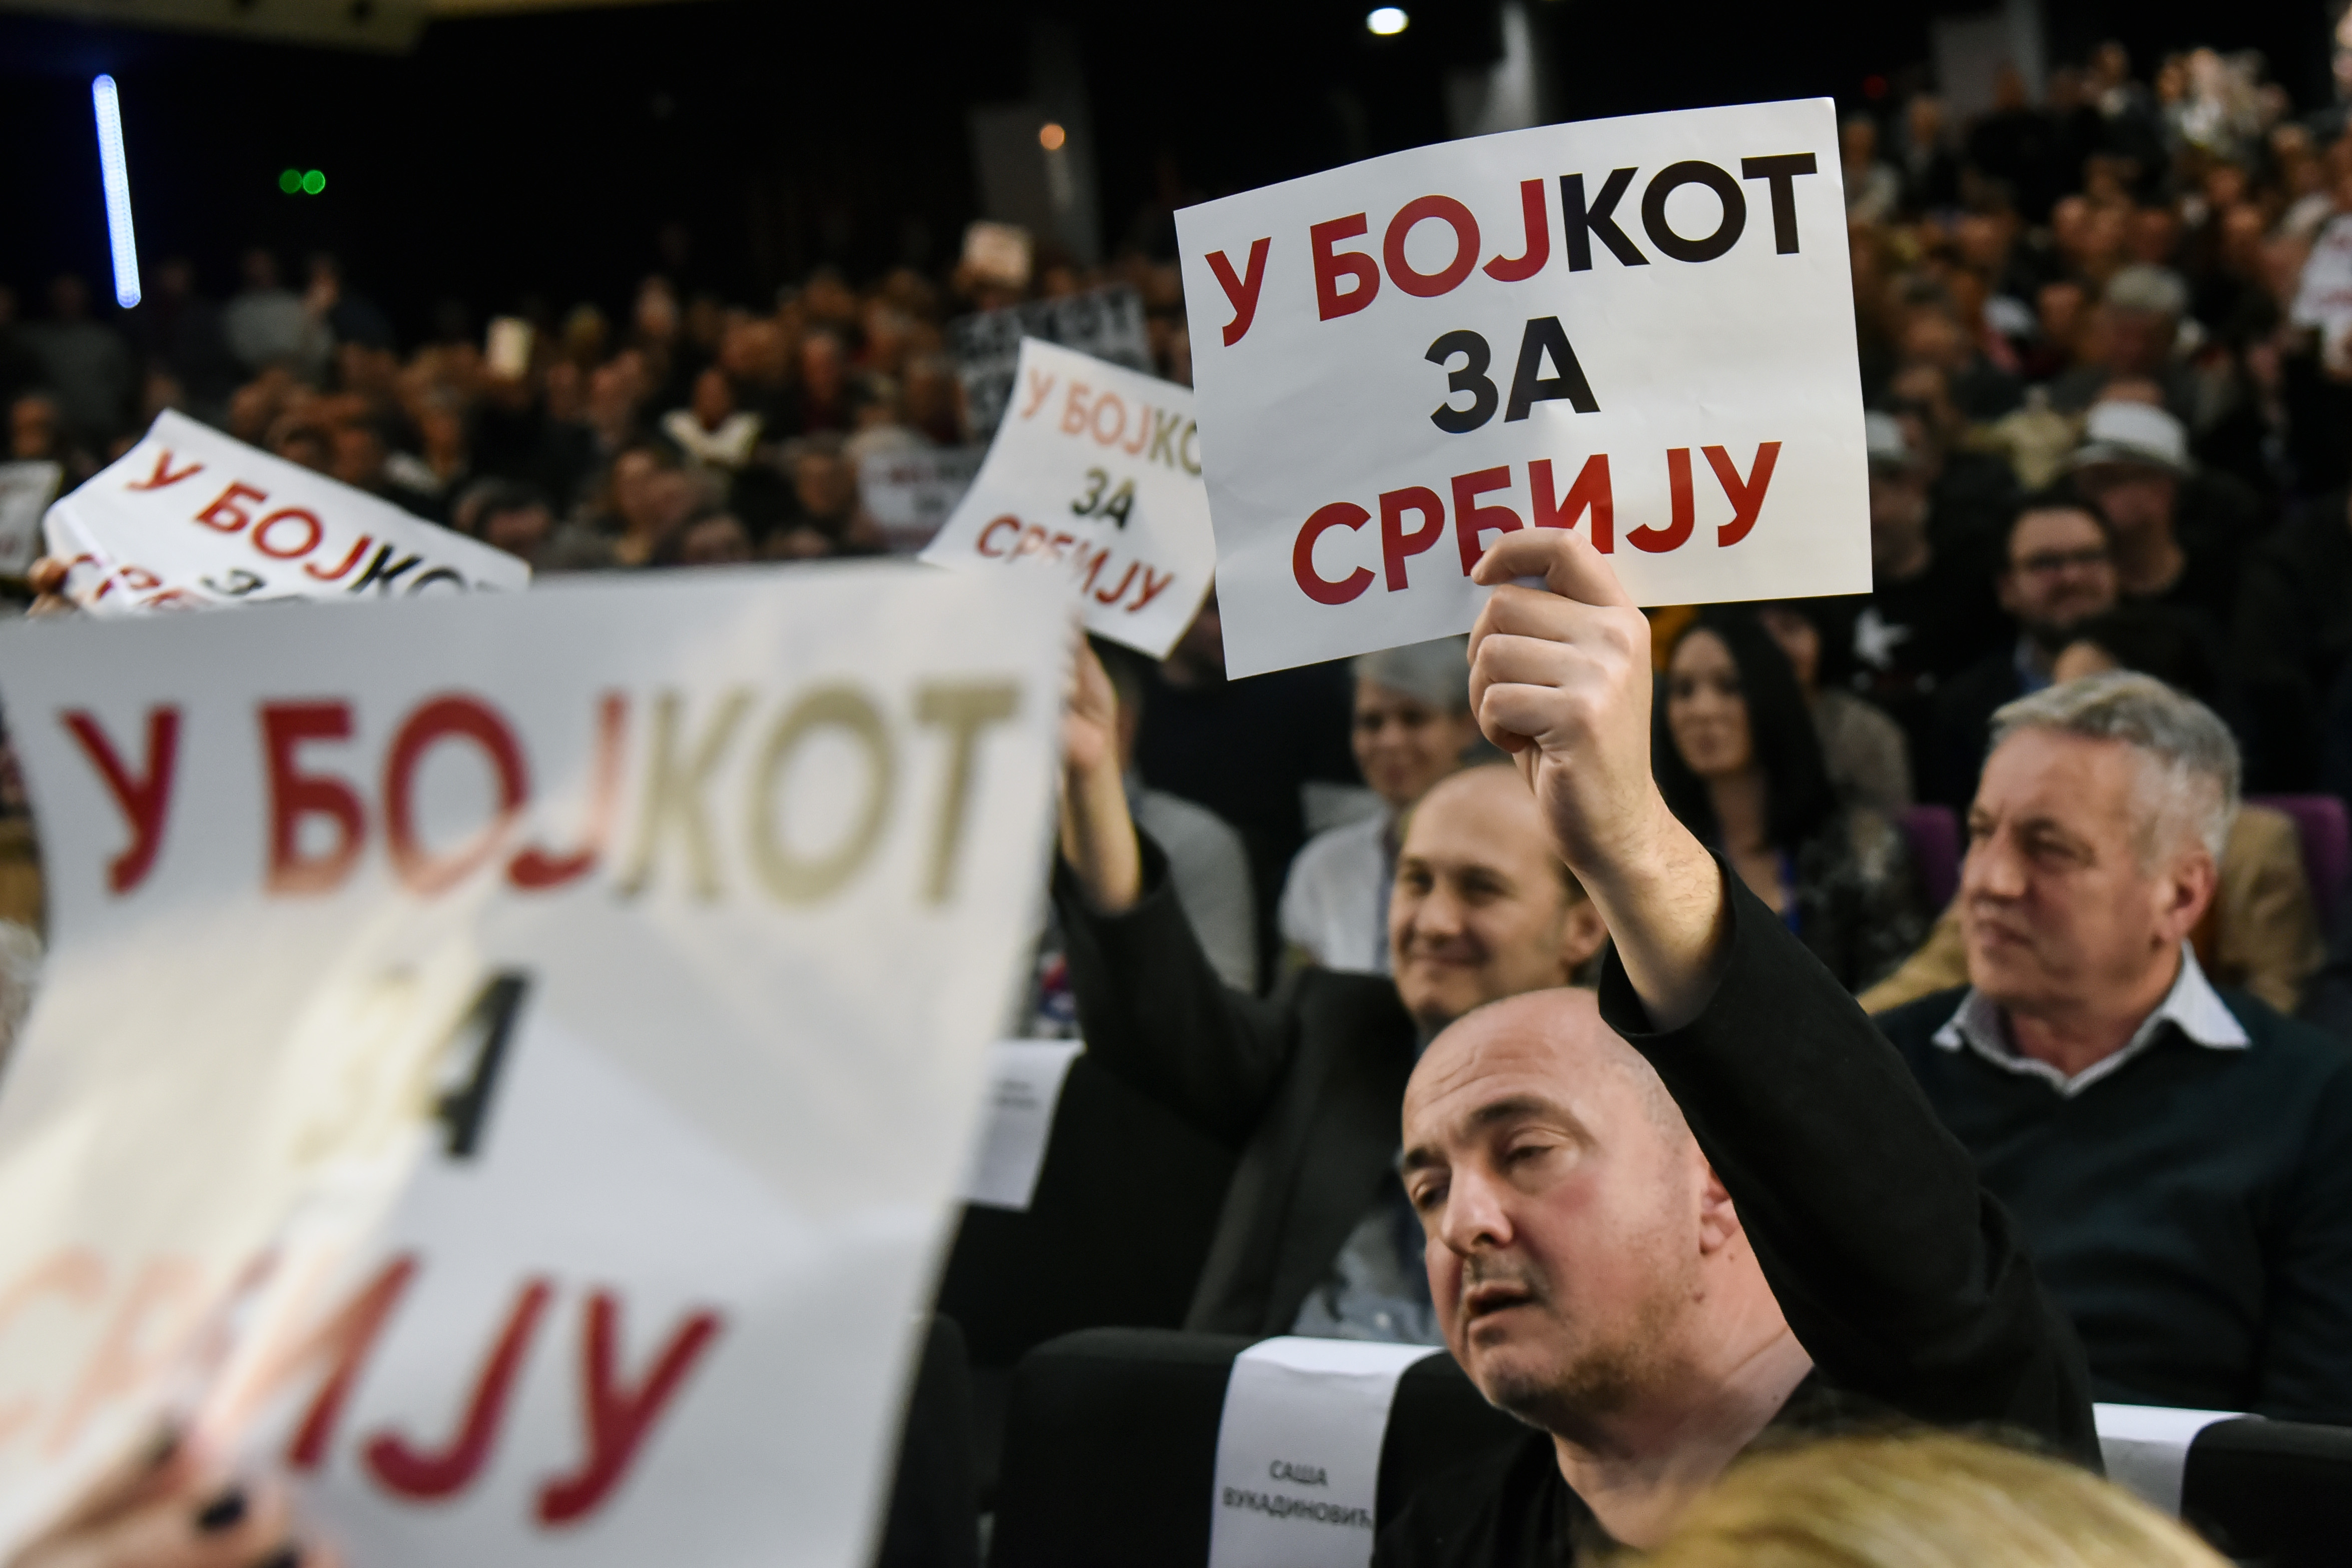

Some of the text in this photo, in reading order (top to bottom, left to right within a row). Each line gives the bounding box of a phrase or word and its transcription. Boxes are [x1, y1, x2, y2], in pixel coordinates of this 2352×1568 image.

[1204, 237, 1272, 347] У
[1310, 152, 1818, 322] БОЈКОТ
[1021, 369, 1054, 420] У
[1059, 379, 1203, 477] БОЈКО
[1424, 316, 1601, 434] ЗА
[125, 450, 206, 492] У
[192, 480, 503, 599] БОЈК
[1070, 466, 1137, 531] ЗА
[1292, 441, 1783, 605] СРБИЈУ
[59, 676, 1026, 908] У БОЈКОТ
[1223, 1486, 1373, 1527] ВУКАДИНОВИЋ
[1269, 1459, 1329, 1486] САША
